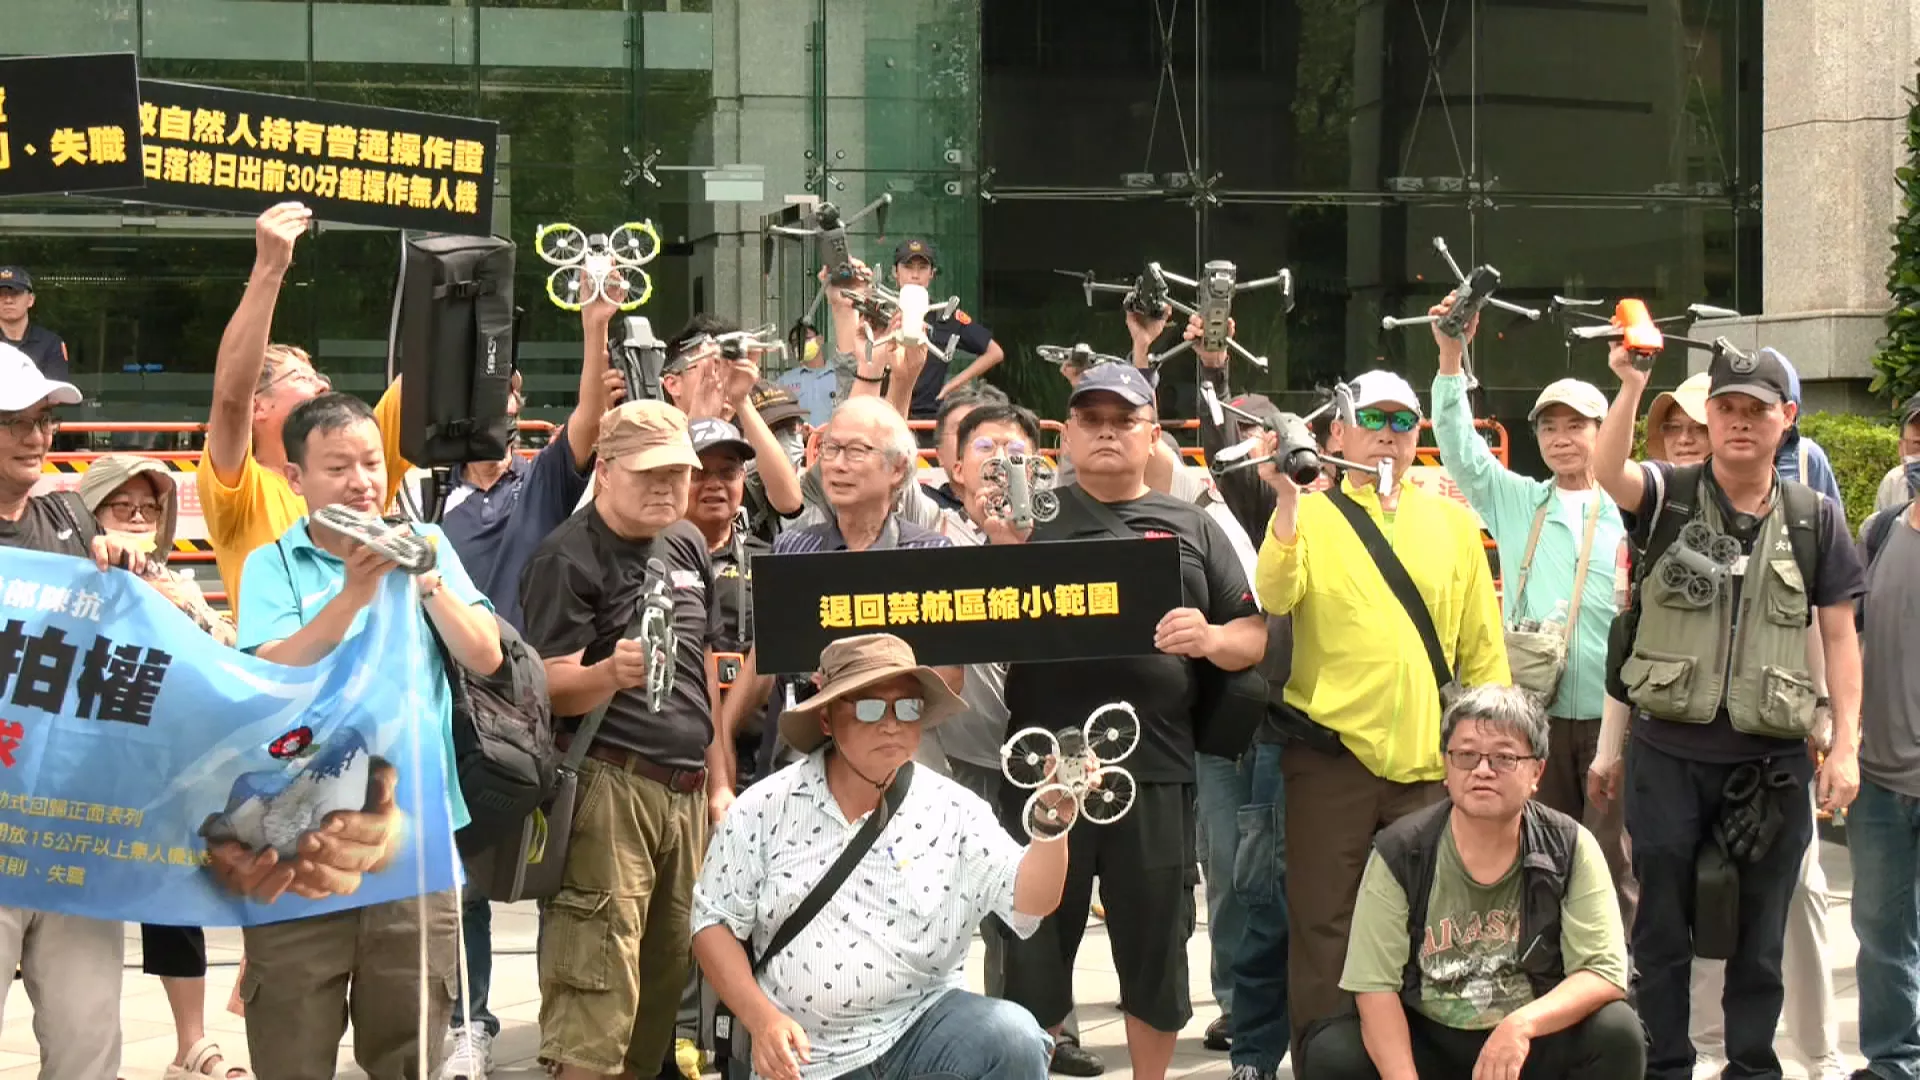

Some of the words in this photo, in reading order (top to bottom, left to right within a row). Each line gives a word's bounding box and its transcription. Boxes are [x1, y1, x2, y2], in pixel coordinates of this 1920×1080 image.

[0, 576, 104, 622] 部陳抗
[819, 582, 1121, 628] 退回禁航區縮小範圍
